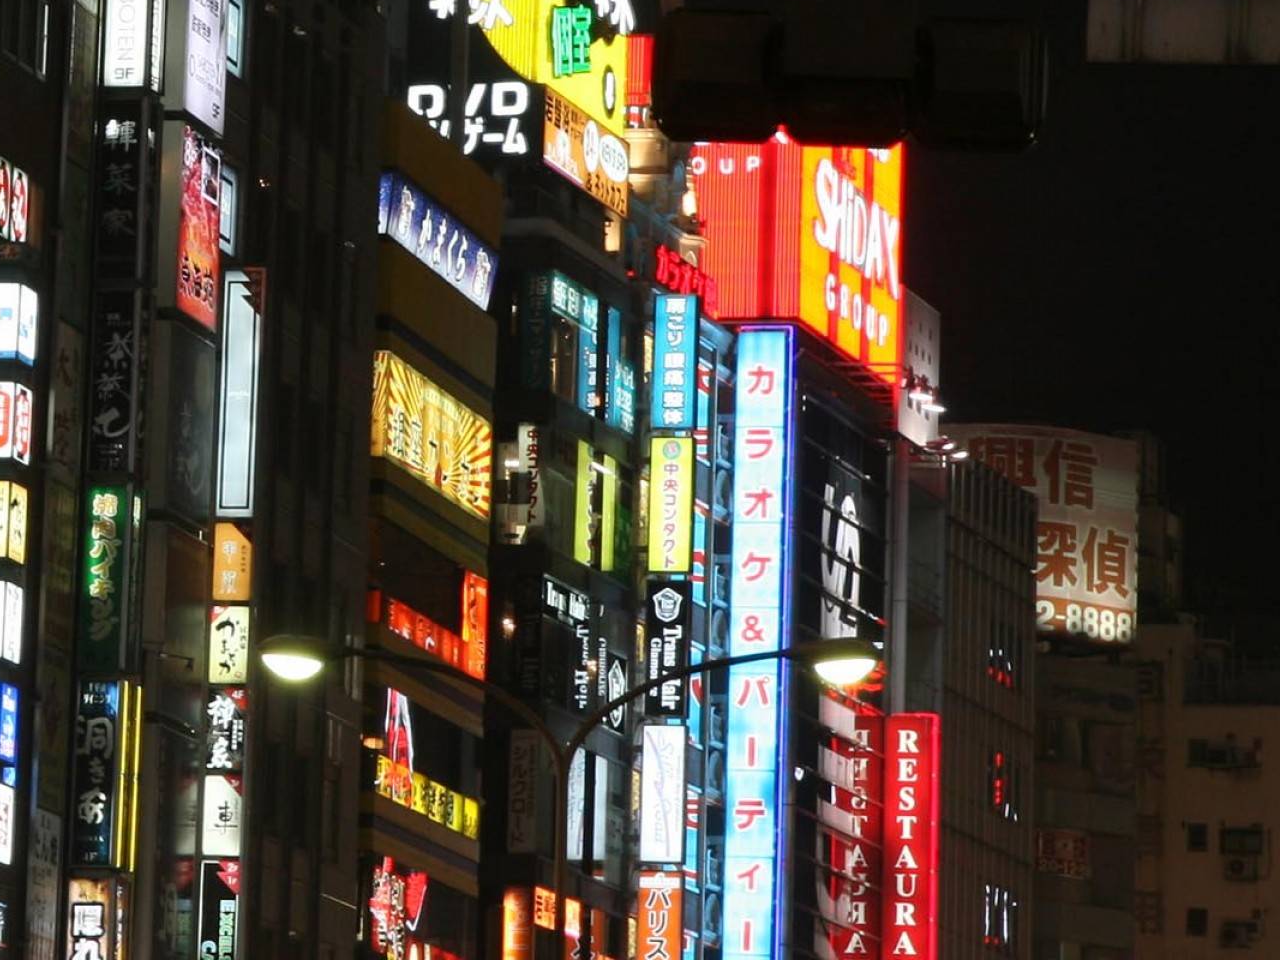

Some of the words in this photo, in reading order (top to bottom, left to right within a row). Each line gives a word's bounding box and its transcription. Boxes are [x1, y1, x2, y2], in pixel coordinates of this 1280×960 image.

[825, 274, 889, 347] GROUP
[662, 462, 681, 569] 中央コンタクト
[1032, 520, 1130, 598] 探偵
[893, 729, 921, 955] RESTAURA
